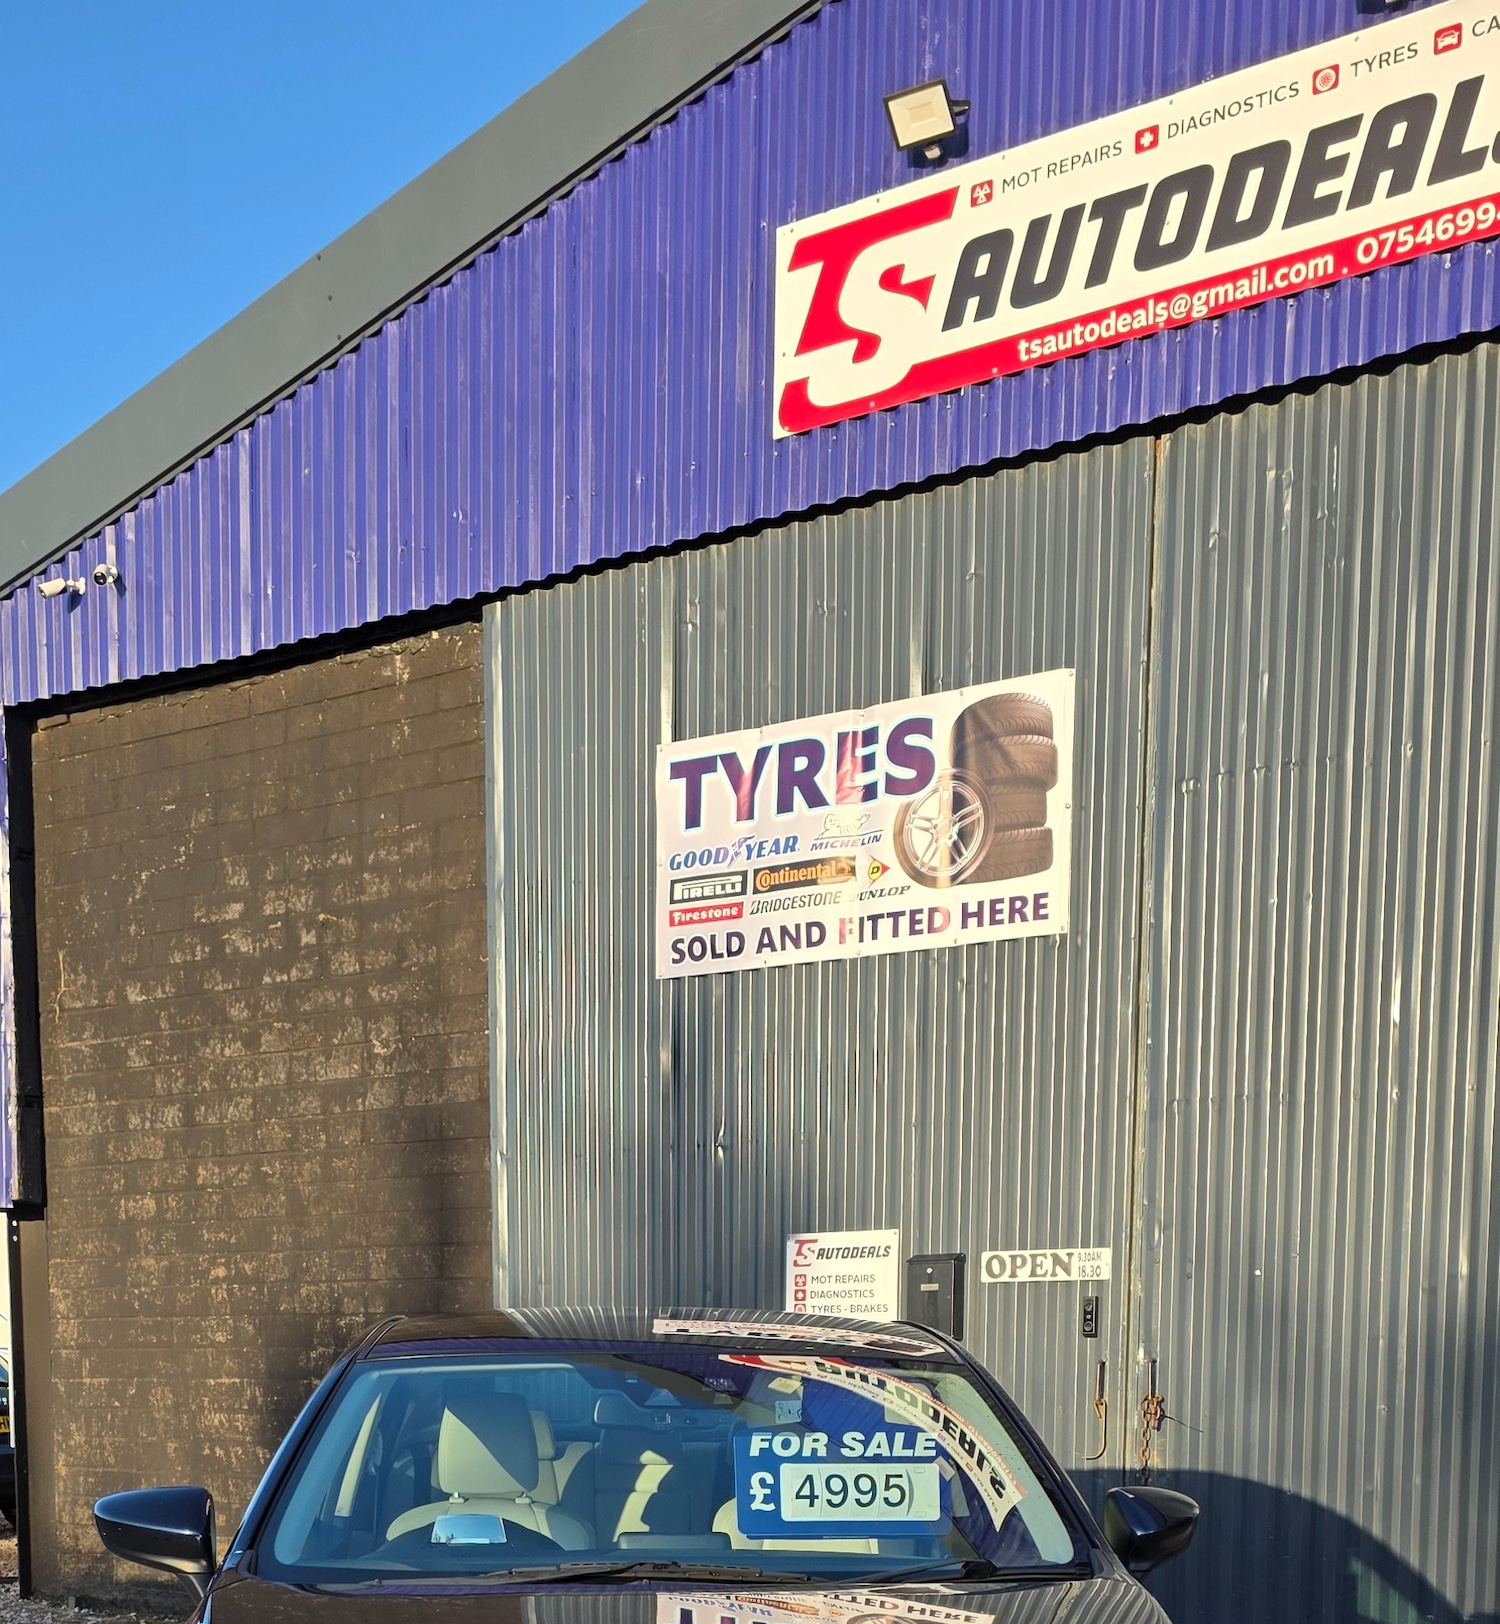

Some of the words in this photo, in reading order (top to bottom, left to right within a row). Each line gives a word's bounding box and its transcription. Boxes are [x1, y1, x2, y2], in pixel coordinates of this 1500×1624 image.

[1350, 42, 1418, 77] TYRES
[1167, 81, 1300, 140] DIAGNOSTICS
[1002, 166, 1042, 194] MOT
[1047, 141, 1123, 180] REPAIRS
[942, 74, 1500, 332] AUTODEAL
[1017, 249, 1334, 361] tsautodeals@gmail.com
[1356, 202, 1500, 264] 0754699
[669, 717, 936, 830] TYRES
[811, 834, 883, 851] MICHELIN
[673, 874, 743, 901] PIRELLI
[755, 859, 836, 892] Continental
[672, 905, 739, 923] Firestone
[750, 890, 841, 915] BRIDGESTONE
[670, 930, 746, 965] SOLD
[755, 920, 827, 955] AND
[838, 905, 951, 945] FITTED
[960, 892, 1050, 930] HERE
[815, 1244, 891, 1261] AUTODEALS
[985, 1252, 1075, 1279] OPEN
[810, 1274, 833, 1285] MOT
[834, 1273, 876, 1285] REPAIRS
[1077, 1264, 1102, 1279] 18.30
[810, 1288, 875, 1300] DIAGNOSTICS
[810, 1304, 841, 1315] TYRES
[850, 1303, 889, 1314] BRAKES
[749, 1431, 829, 1458] FOR
[840, 1431, 938, 1458] SALE
[749, 1470, 776, 1511] £
[794, 1473, 907, 1509] 4995
